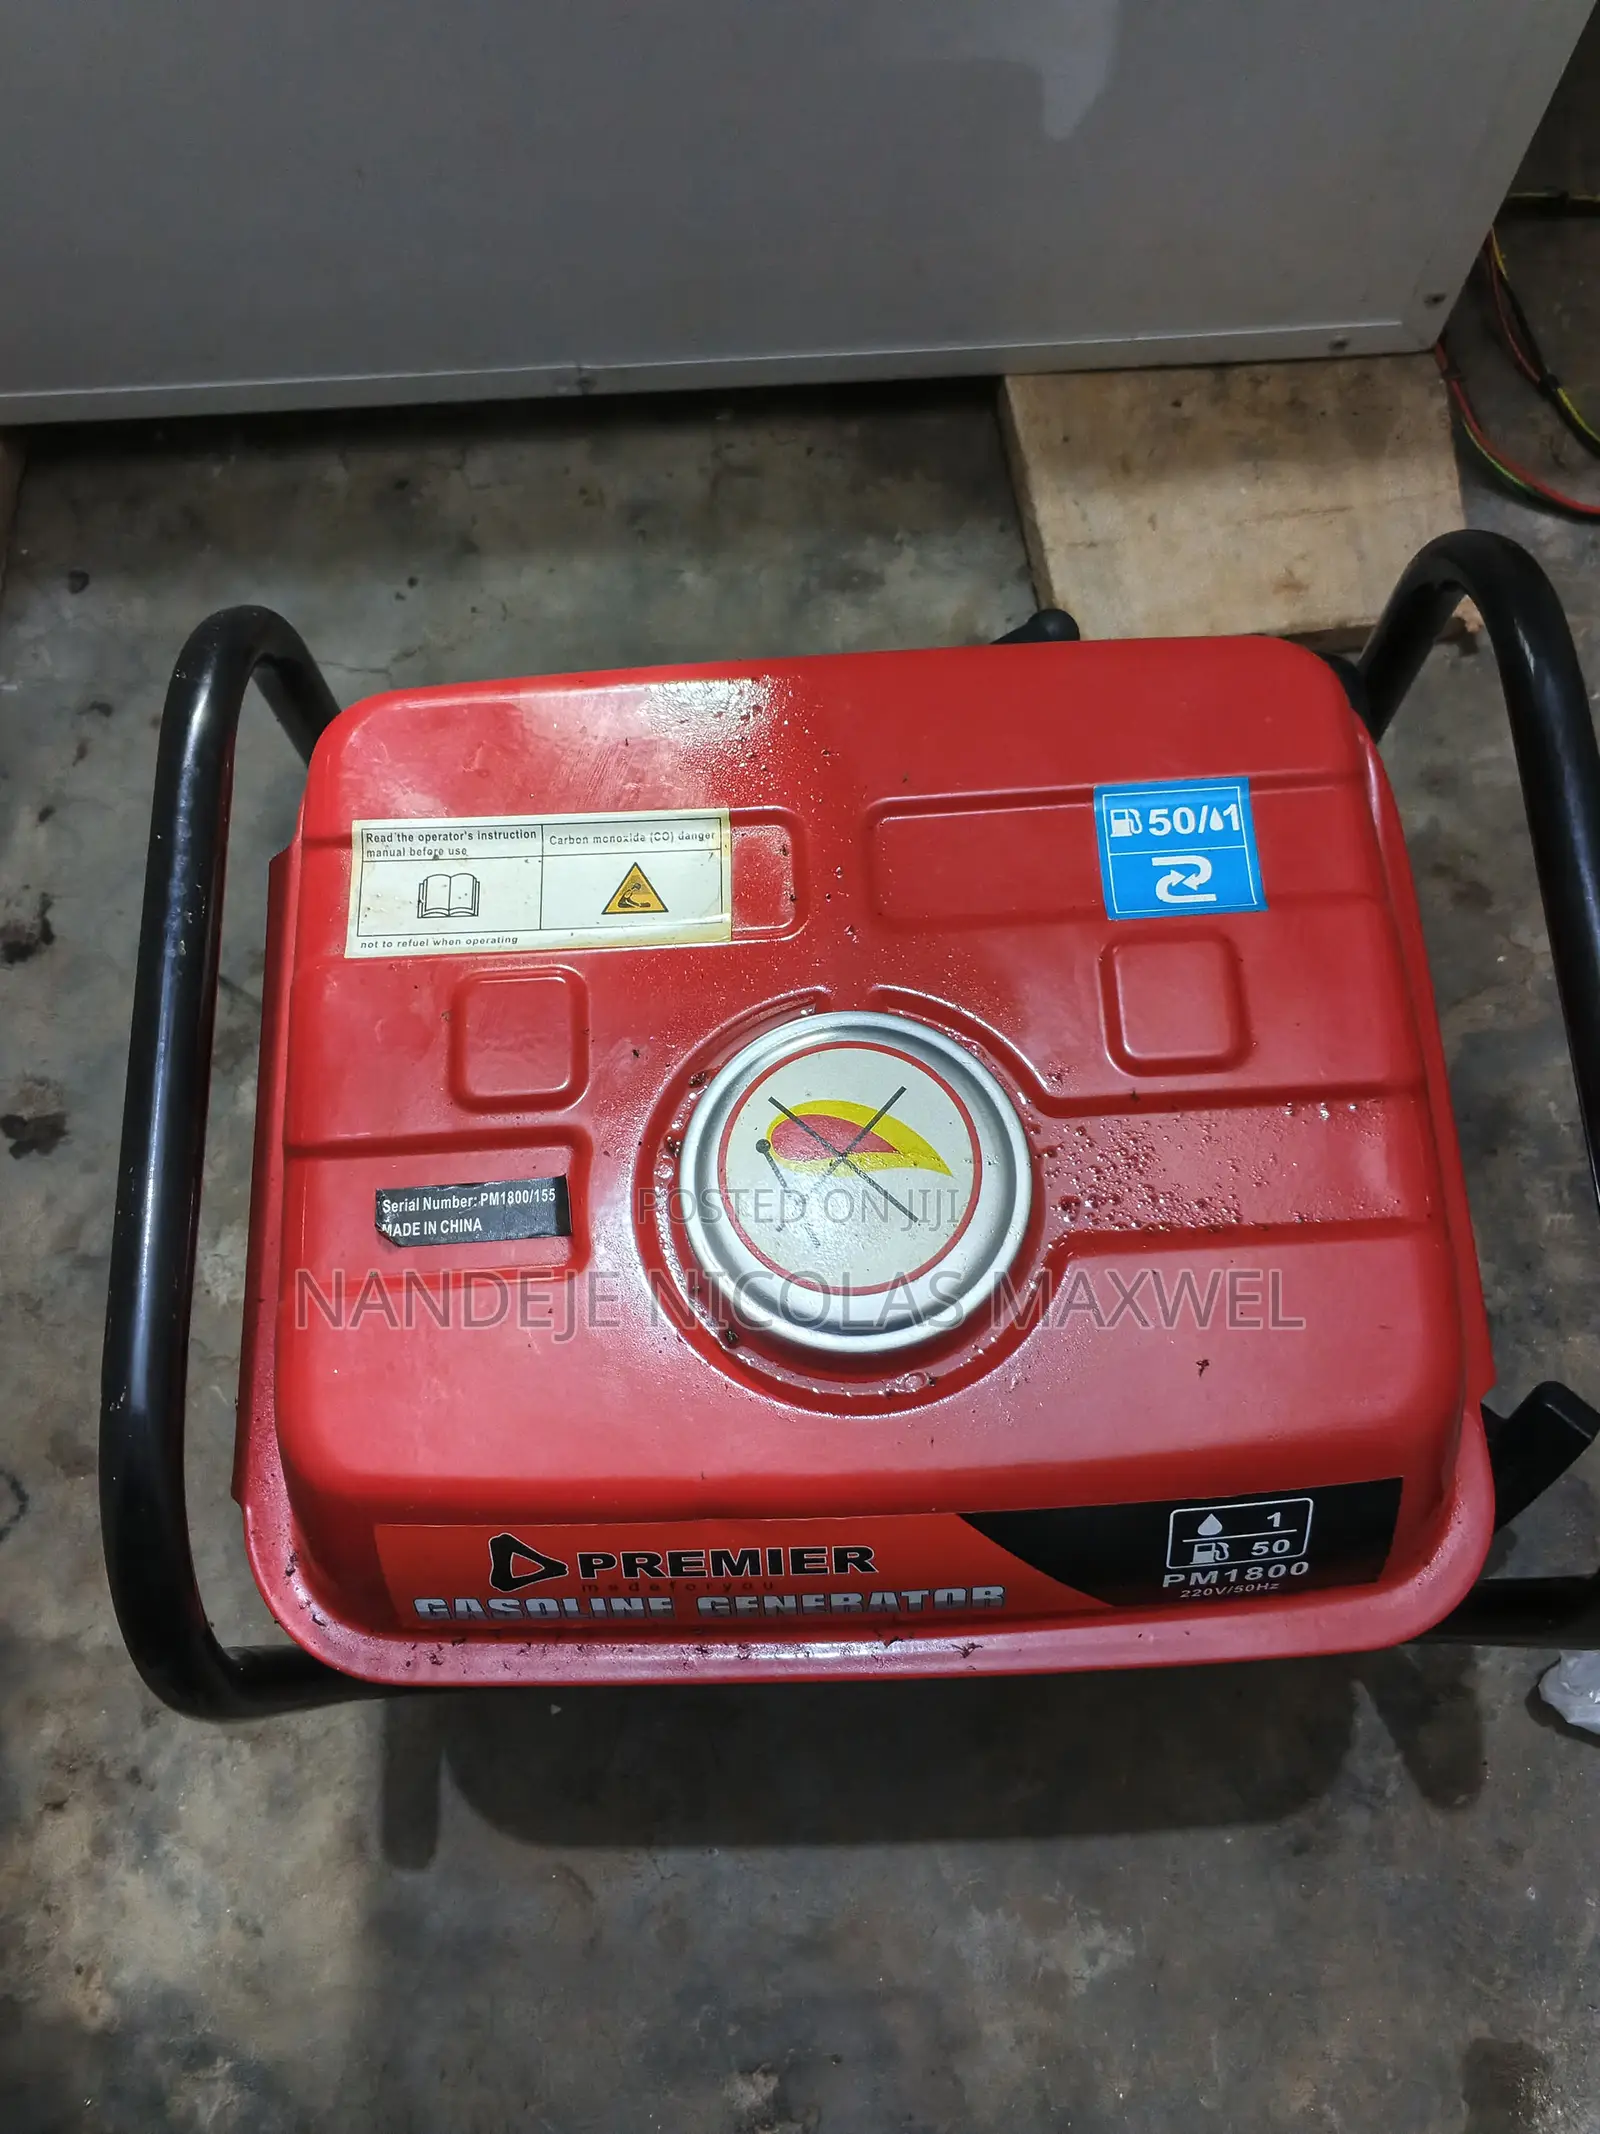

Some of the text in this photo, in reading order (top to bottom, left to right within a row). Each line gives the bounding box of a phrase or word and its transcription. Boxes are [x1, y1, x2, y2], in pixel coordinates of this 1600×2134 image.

[366, 833, 392, 844] Read
[398, 831, 413, 843] the
[417, 830, 474, 845] operator's
[549, 834, 589, 846] Carbon
[650, 830, 674, 844] (CO)
[678, 830, 715, 845] danger
[366, 846, 467, 858] manual before use
[360, 936, 519, 949] not to refuel when operating
[382, 1187, 557, 1213] Serial Number: PM1800/155
[382, 1218, 483, 1237] MADE IN CHINA
[1267, 1511, 1282, 1528] 1
[1250, 1538, 1291, 1556] 50
[576, 1544, 878, 1580] PREMIER
[1162, 1561, 1310, 1588] PM1800
[1179, 1582, 1280, 1598] 220V/50Hz
[413, 1584, 1008, 1621] GASOLINE GENERATOR
